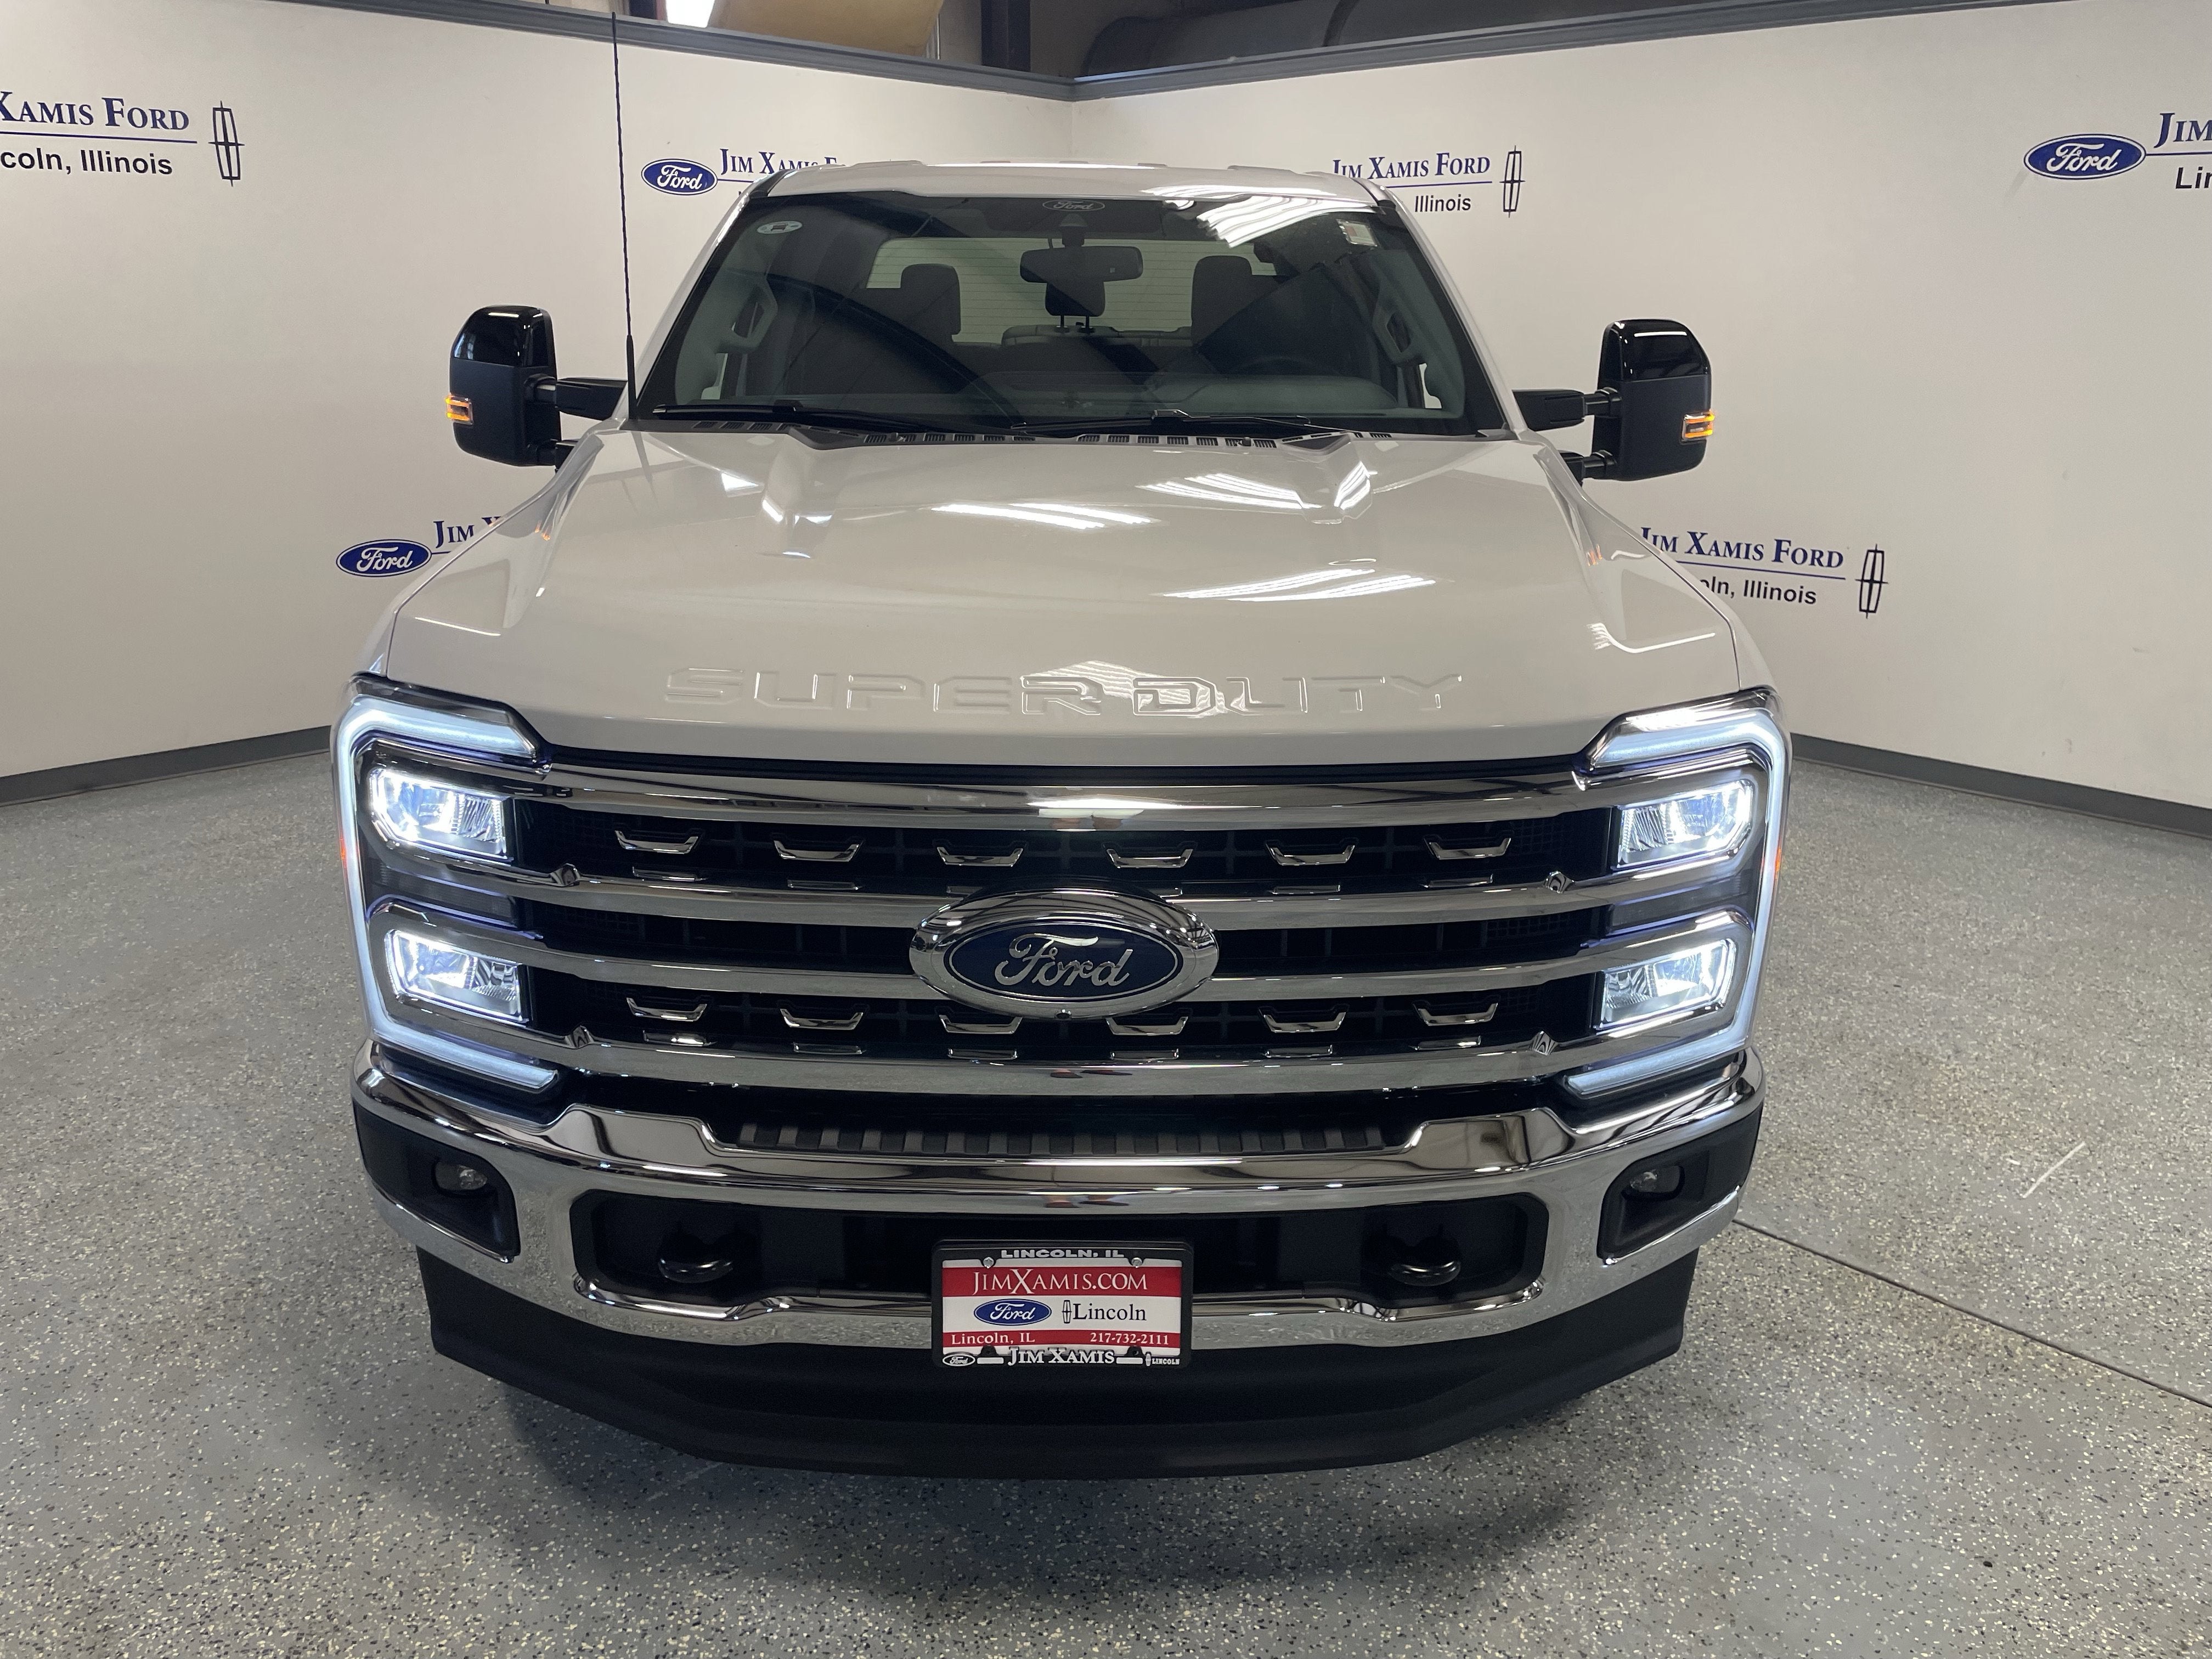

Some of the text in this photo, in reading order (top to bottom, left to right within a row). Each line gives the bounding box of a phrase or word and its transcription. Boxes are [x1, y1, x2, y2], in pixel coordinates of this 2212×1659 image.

[101, 97, 189, 130] FORD
[81, 150, 173, 174] Illinois
[719, 148, 754, 176] JIM
[1368, 156, 1429, 179] XAMIS
[1435, 152, 1491, 176] FORD
[2046, 143, 2122, 172] Ford
[657, 165, 703, 189] Ford
[1053, 201, 1094, 210] Ford
[1414, 194, 1471, 212] Illinois
[433, 521, 475, 549] JIM
[357, 546, 413, 572] Ford
[1684, 531, 1764, 561] XAMIS
[1771, 539, 1844, 568] FORD
[1743, 579, 1817, 605] Illinois
[664, 668, 1462, 716] SUPER DUTY
[994, 933, 1133, 987] Ford
[1001, 1250, 1125, 1259] LINCOLN, IL
[972, 1268, 1148, 1296] JIMXAMIS.COM
[989, 1303, 1147, 1321] Ford Lincoln
[951, 1332, 1169, 1345] Lincoln, IL 217-732-2111
[1007, 1346, 1045, 1367] JIM
[1048, 1347, 1115, 1364] XAMIS
